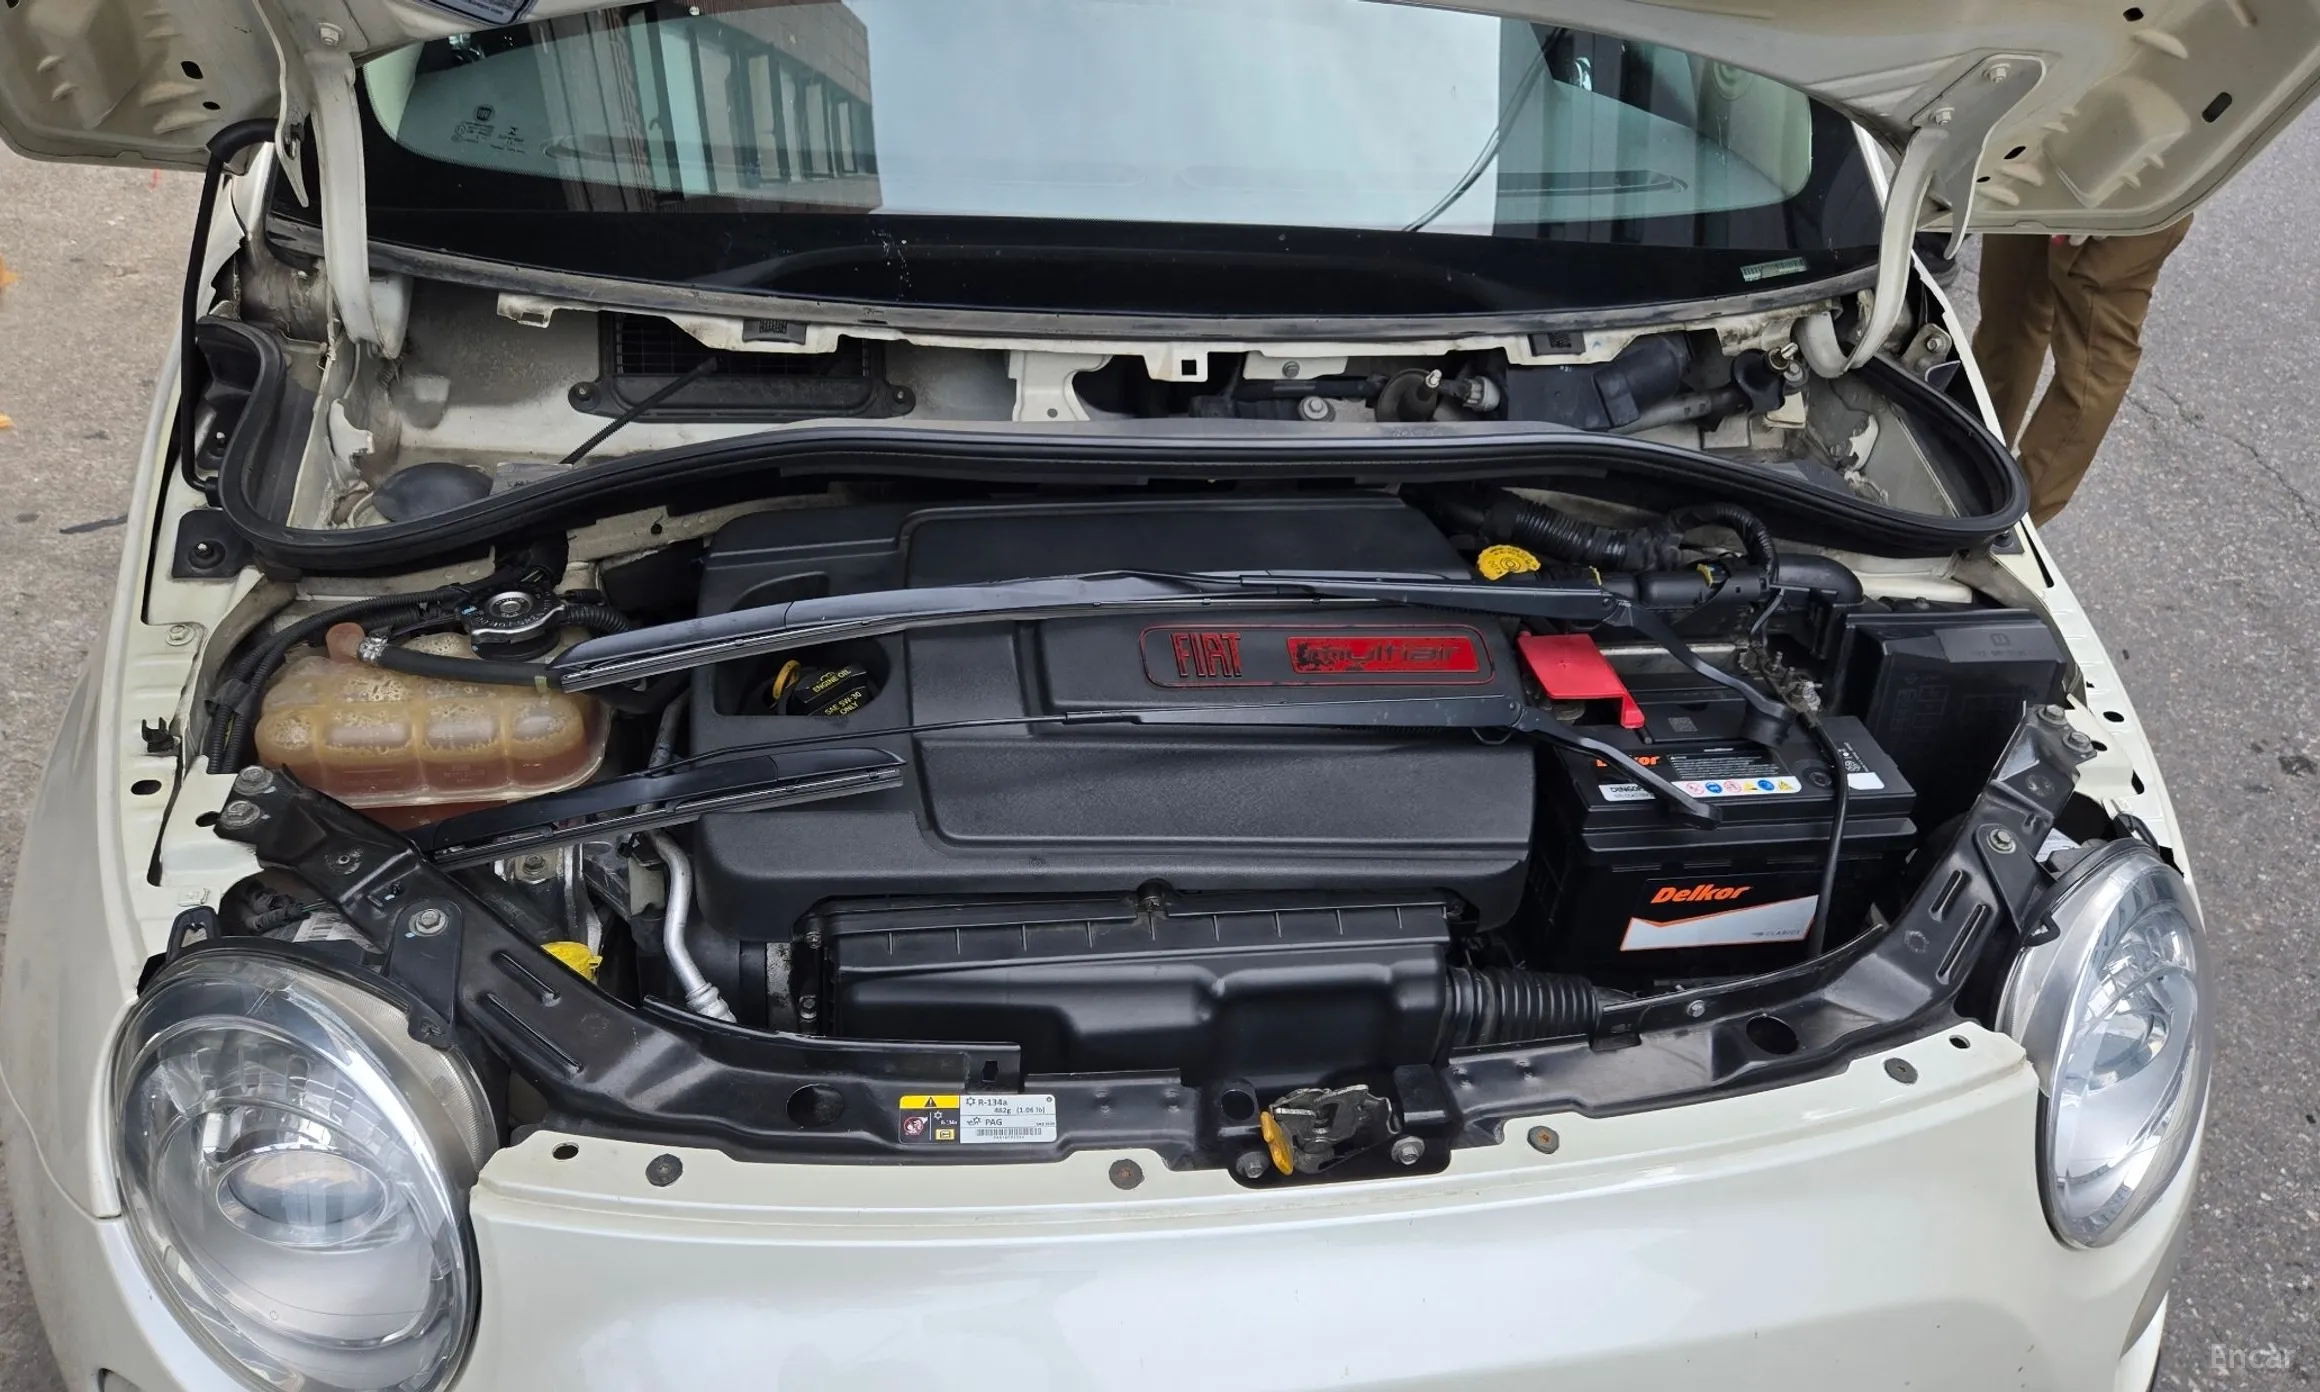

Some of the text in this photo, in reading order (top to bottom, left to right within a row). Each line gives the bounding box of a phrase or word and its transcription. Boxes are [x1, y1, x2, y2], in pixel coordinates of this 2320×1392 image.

[1170, 632, 1242, 678] FIAT
[812, 669, 852, 693] ENGINE OIL
[824, 704, 838, 716] SAE
[839, 701, 859, 715] ONLY
[1650, 884, 1753, 904] Delkor
[985, 1118, 1003, 1126] PAG
